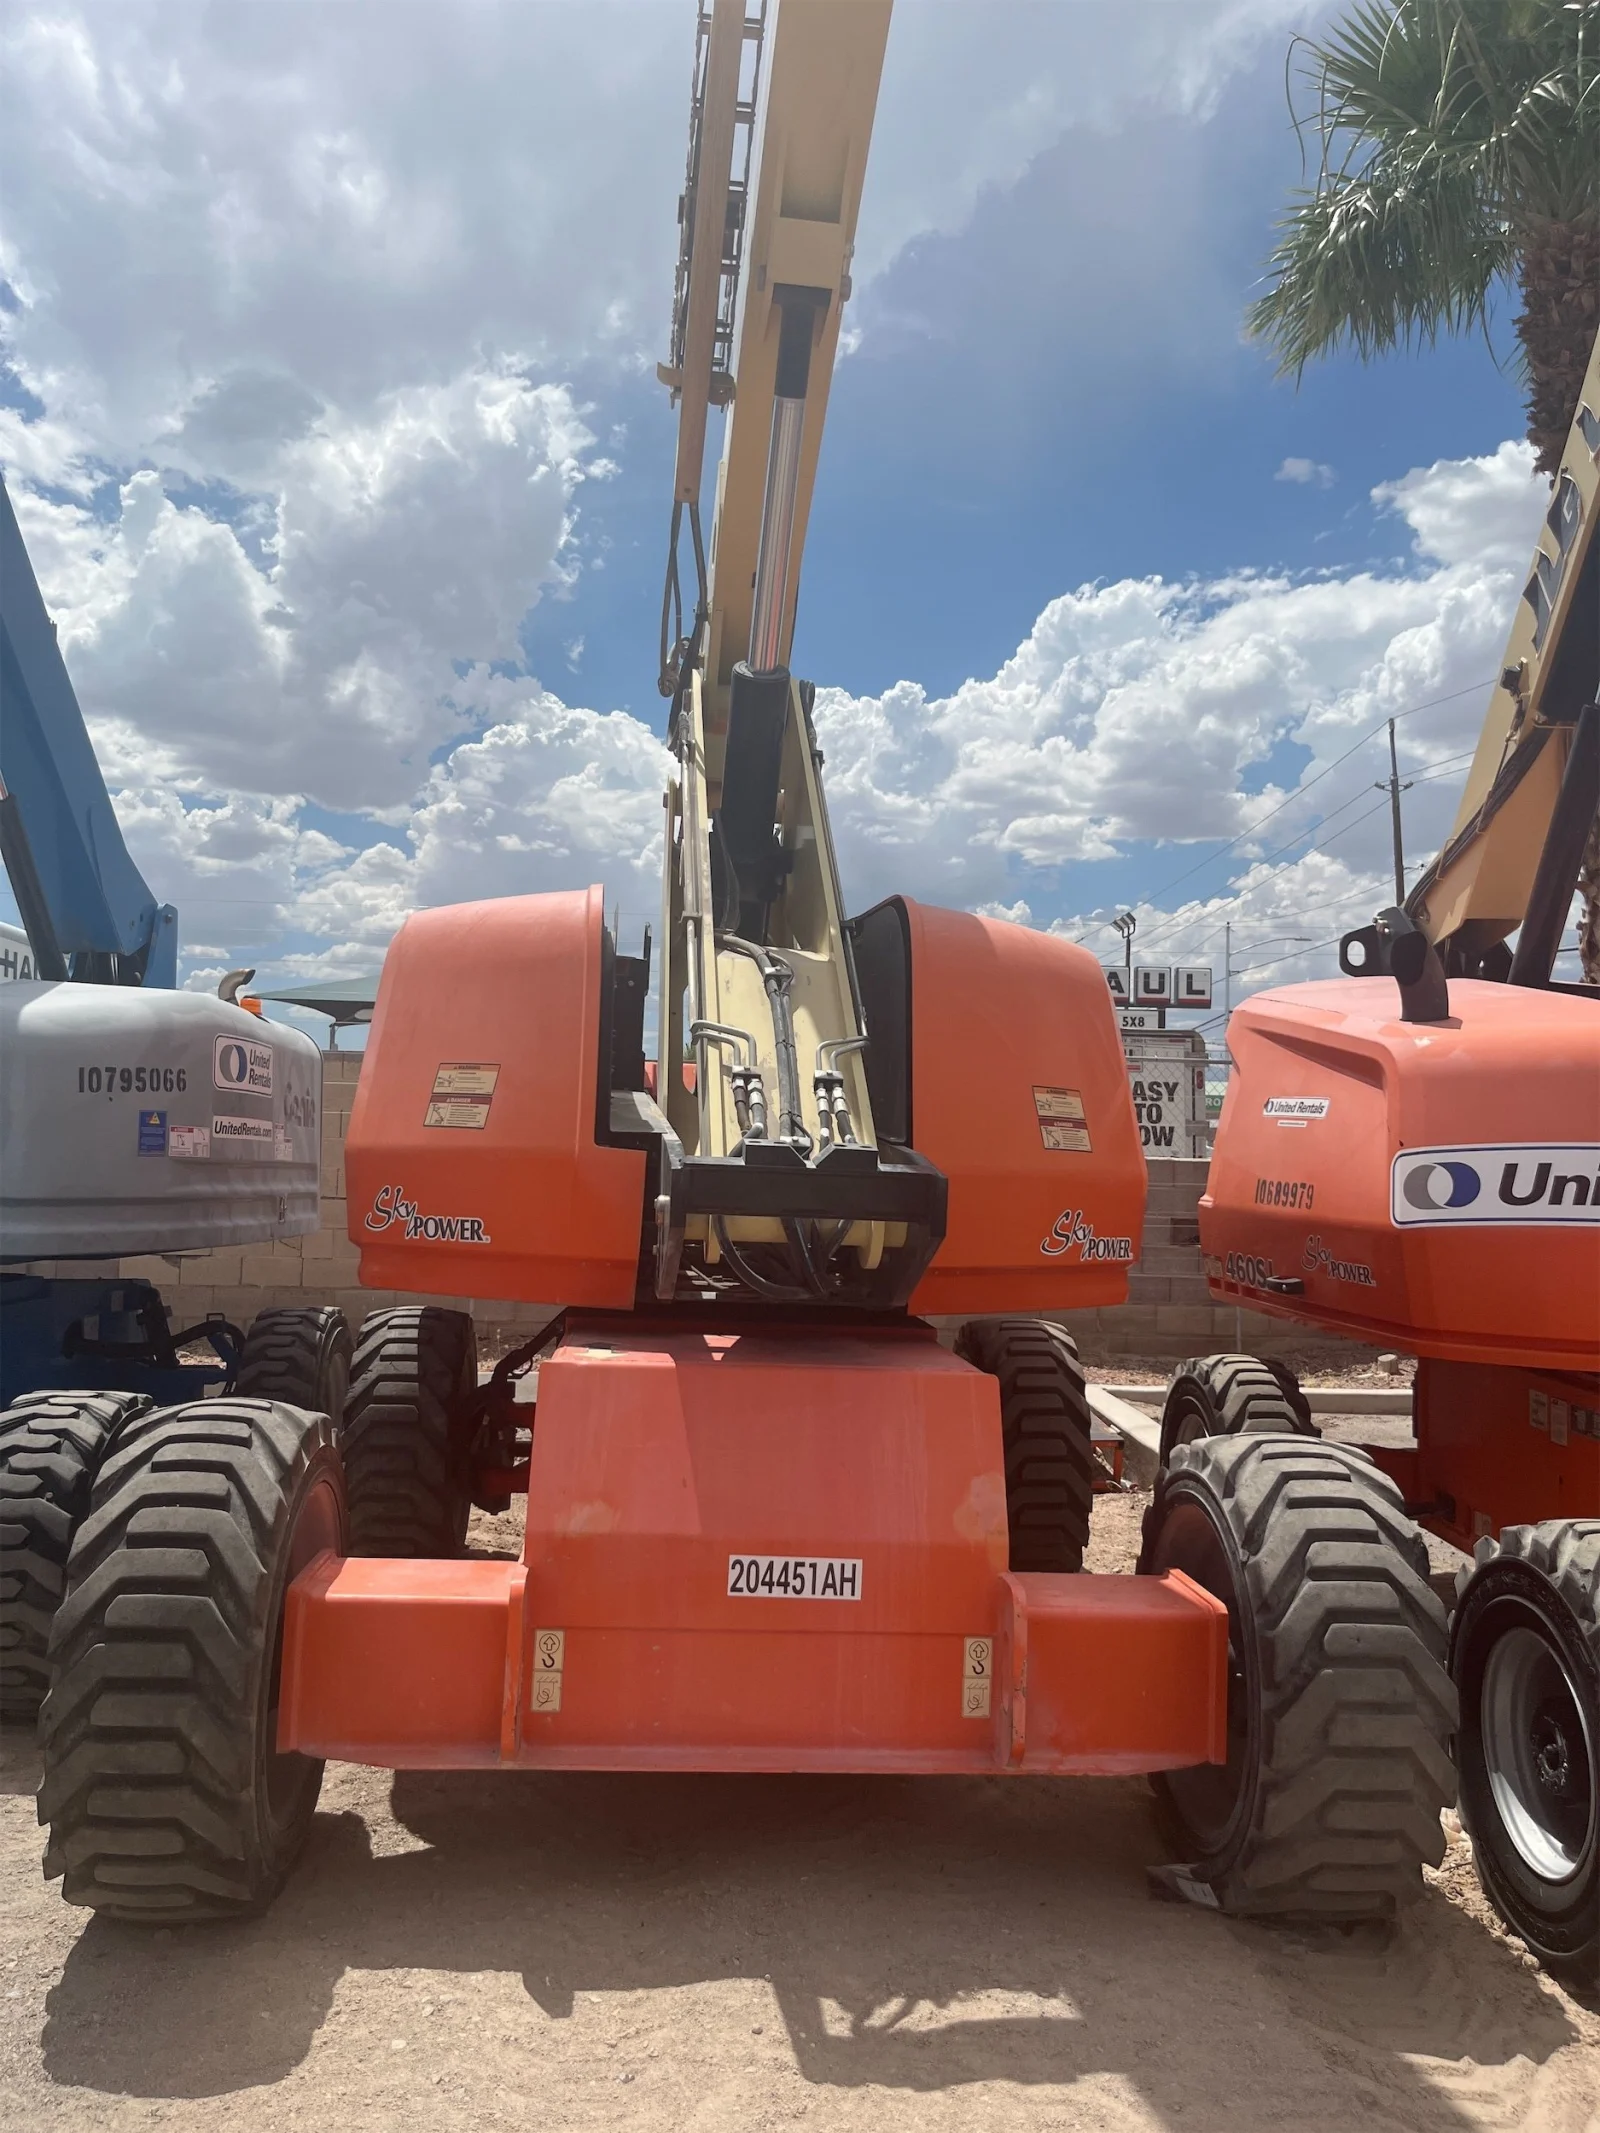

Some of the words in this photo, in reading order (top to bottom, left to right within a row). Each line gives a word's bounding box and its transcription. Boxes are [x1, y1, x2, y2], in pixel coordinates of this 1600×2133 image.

[1122, 1016, 1145, 1028] 5X8
[249, 1048, 272, 1070] United
[248, 1067, 272, 1089] Rentals
[1274, 1101, 1296, 1114] United
[1297, 1101, 1325, 1114] Rentals
[213, 1120, 272, 1138] UnitedRentals.com
[412, 1216, 485, 1242] POWER
[1087, 1237, 1131, 1259] POWER
[1329, 1260, 1373, 1285] POWER
[729, 1558, 857, 1597] 204451AH
